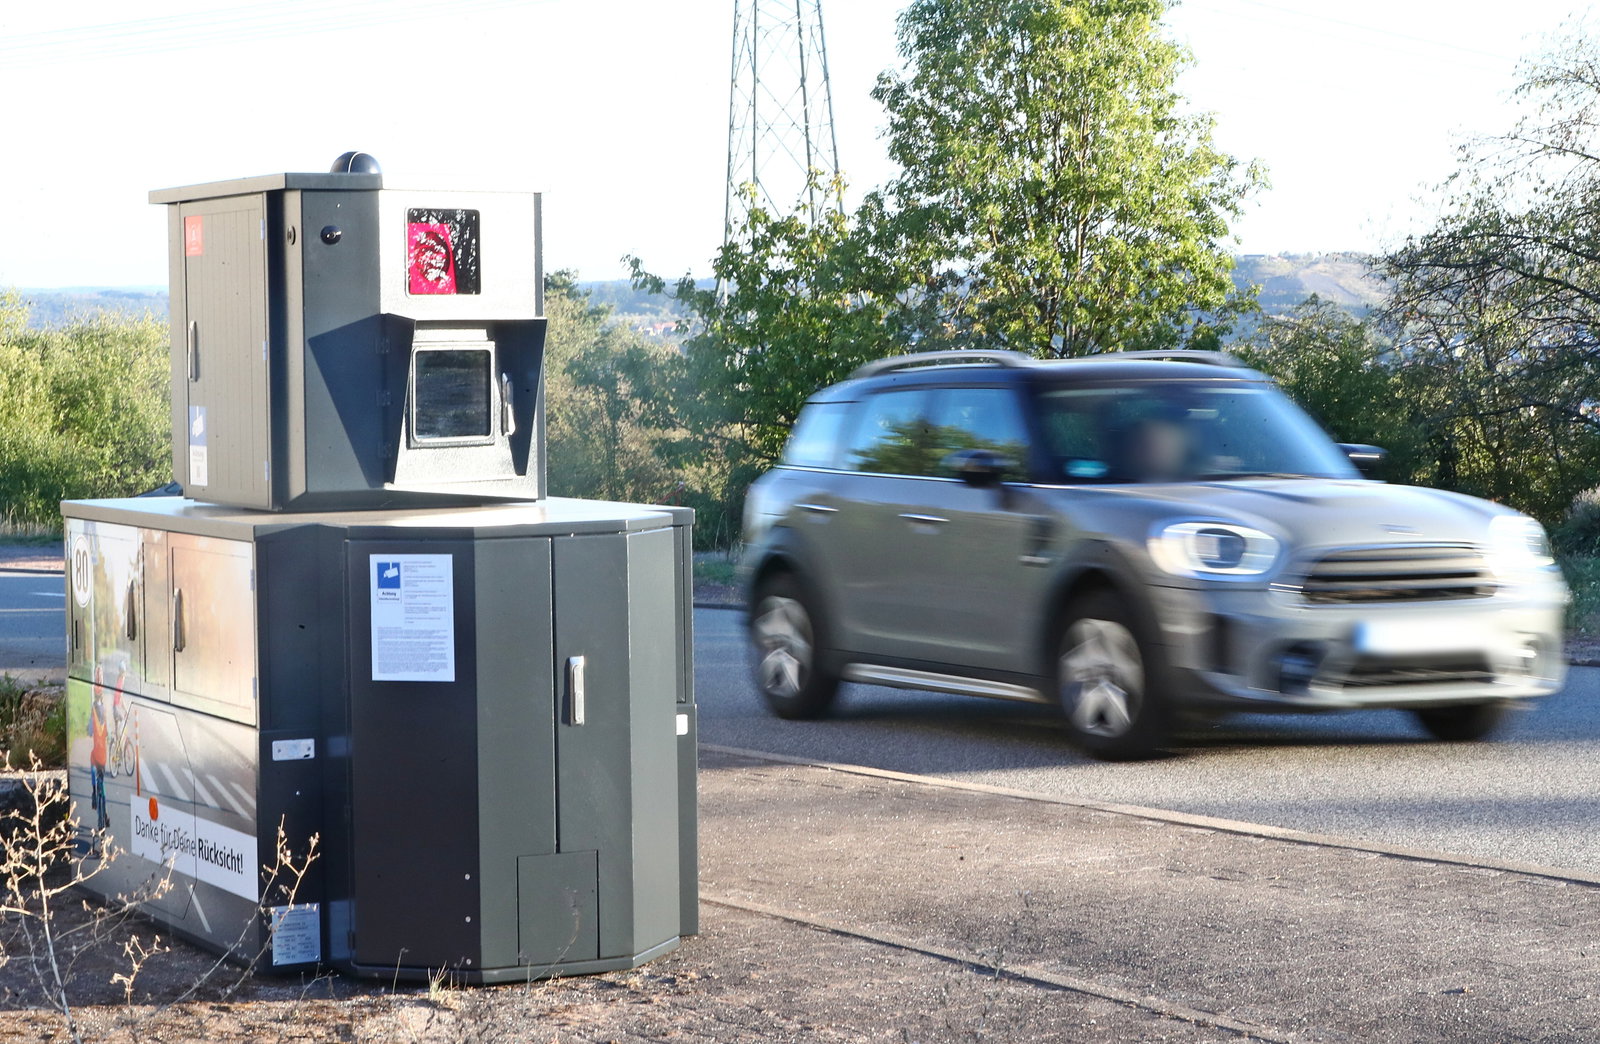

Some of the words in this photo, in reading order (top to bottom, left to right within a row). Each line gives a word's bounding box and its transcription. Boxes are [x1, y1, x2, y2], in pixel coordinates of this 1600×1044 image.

[76, 549, 88, 592] 80
[135, 815, 159, 843] Danke
[161, 822, 173, 849] für
[174, 828, 196, 857] Deine
[198, 838, 243, 874] Rücksicht!
